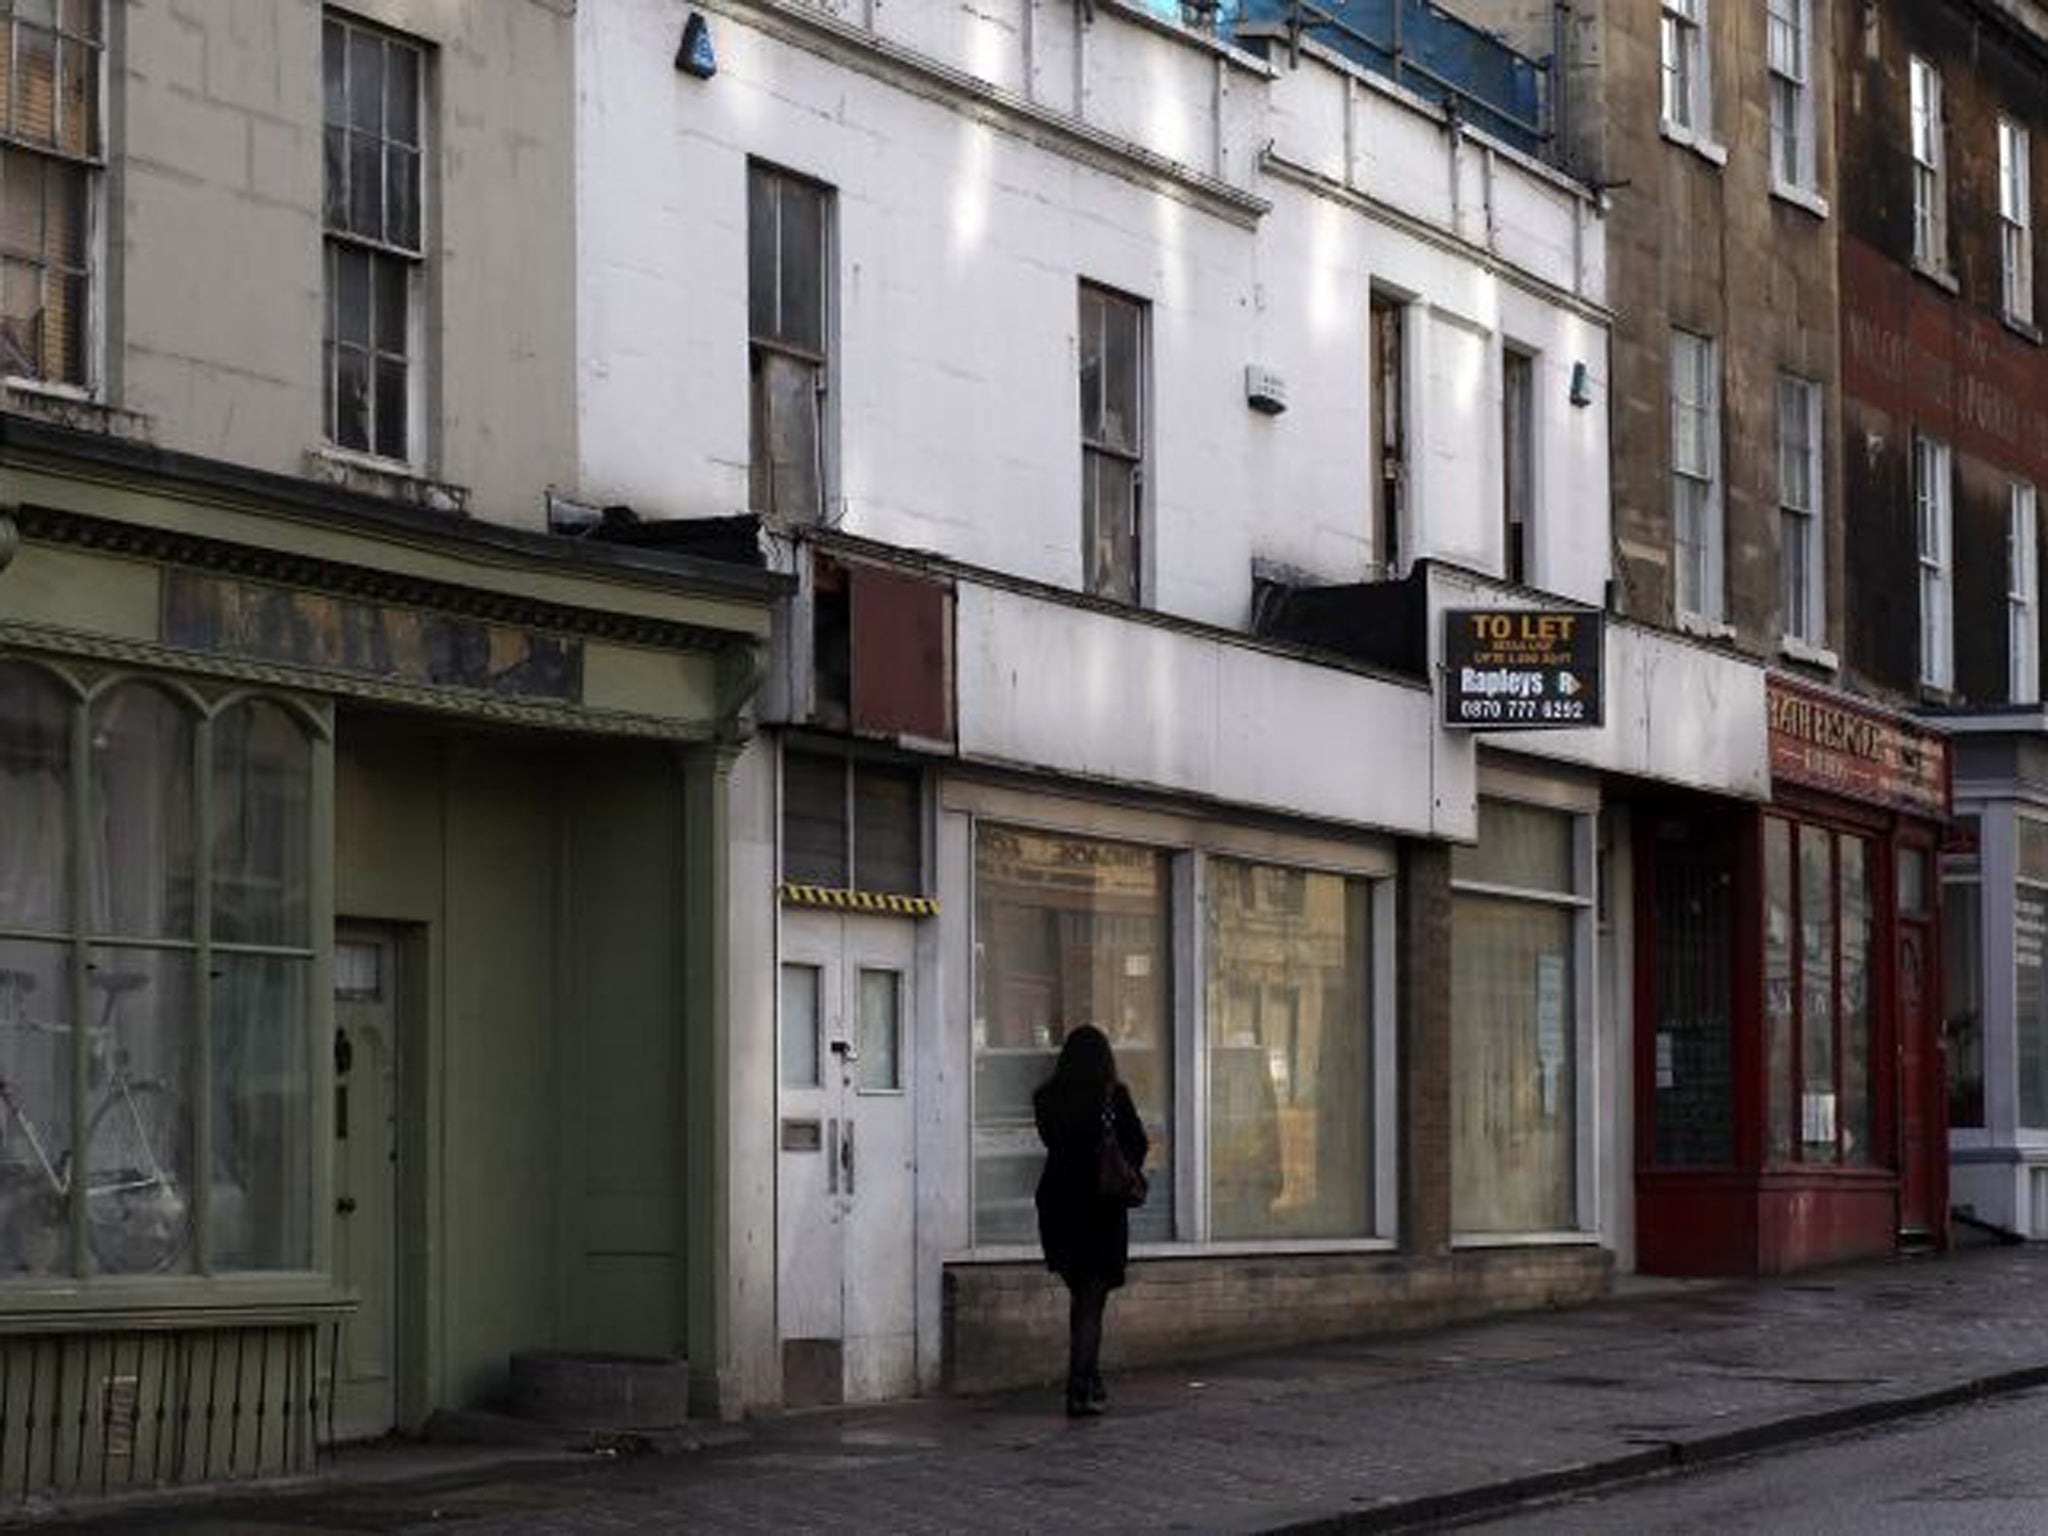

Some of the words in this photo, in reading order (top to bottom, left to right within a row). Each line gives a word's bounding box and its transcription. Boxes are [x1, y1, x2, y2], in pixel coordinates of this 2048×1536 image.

[1471, 614, 1511, 639] TO
[1521, 614, 1575, 639] LET
[1461, 667, 1543, 698] Rapleys
[1460, 700, 1501, 718] 0870
[1508, 700, 1536, 718] 777
